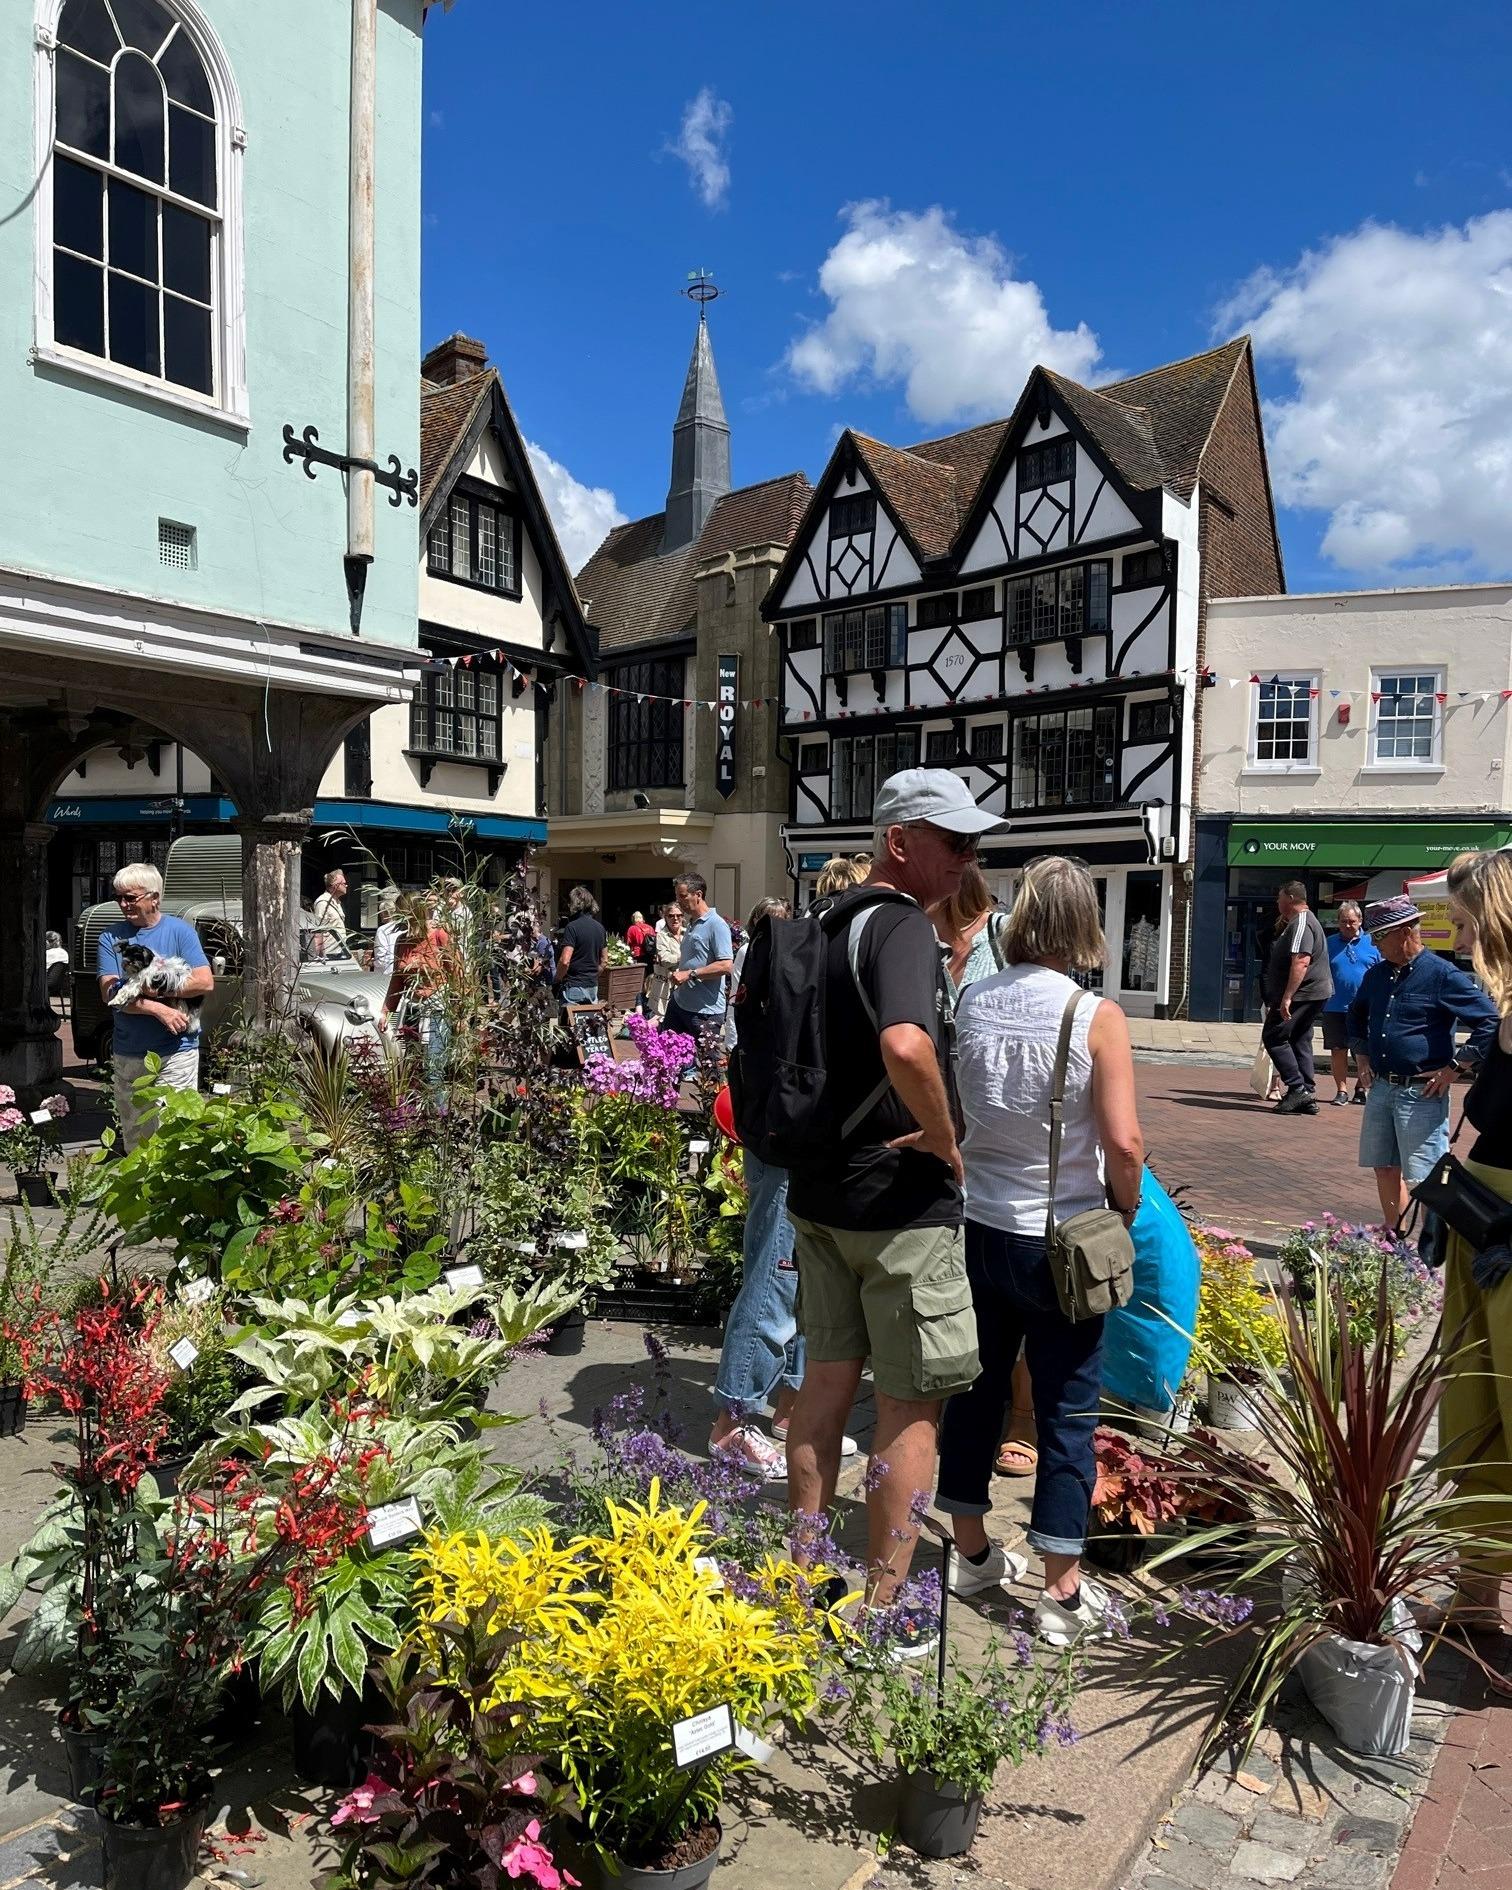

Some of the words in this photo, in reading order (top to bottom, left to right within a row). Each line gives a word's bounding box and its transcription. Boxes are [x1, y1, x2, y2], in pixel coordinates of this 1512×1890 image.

[945, 654, 965, 668] 1570
[720, 668, 736, 678] New
[720, 685, 735, 780] ROYAL
[1263, 842, 1288, 851] YOUR
[1289, 842, 1316, 851] MOVE
